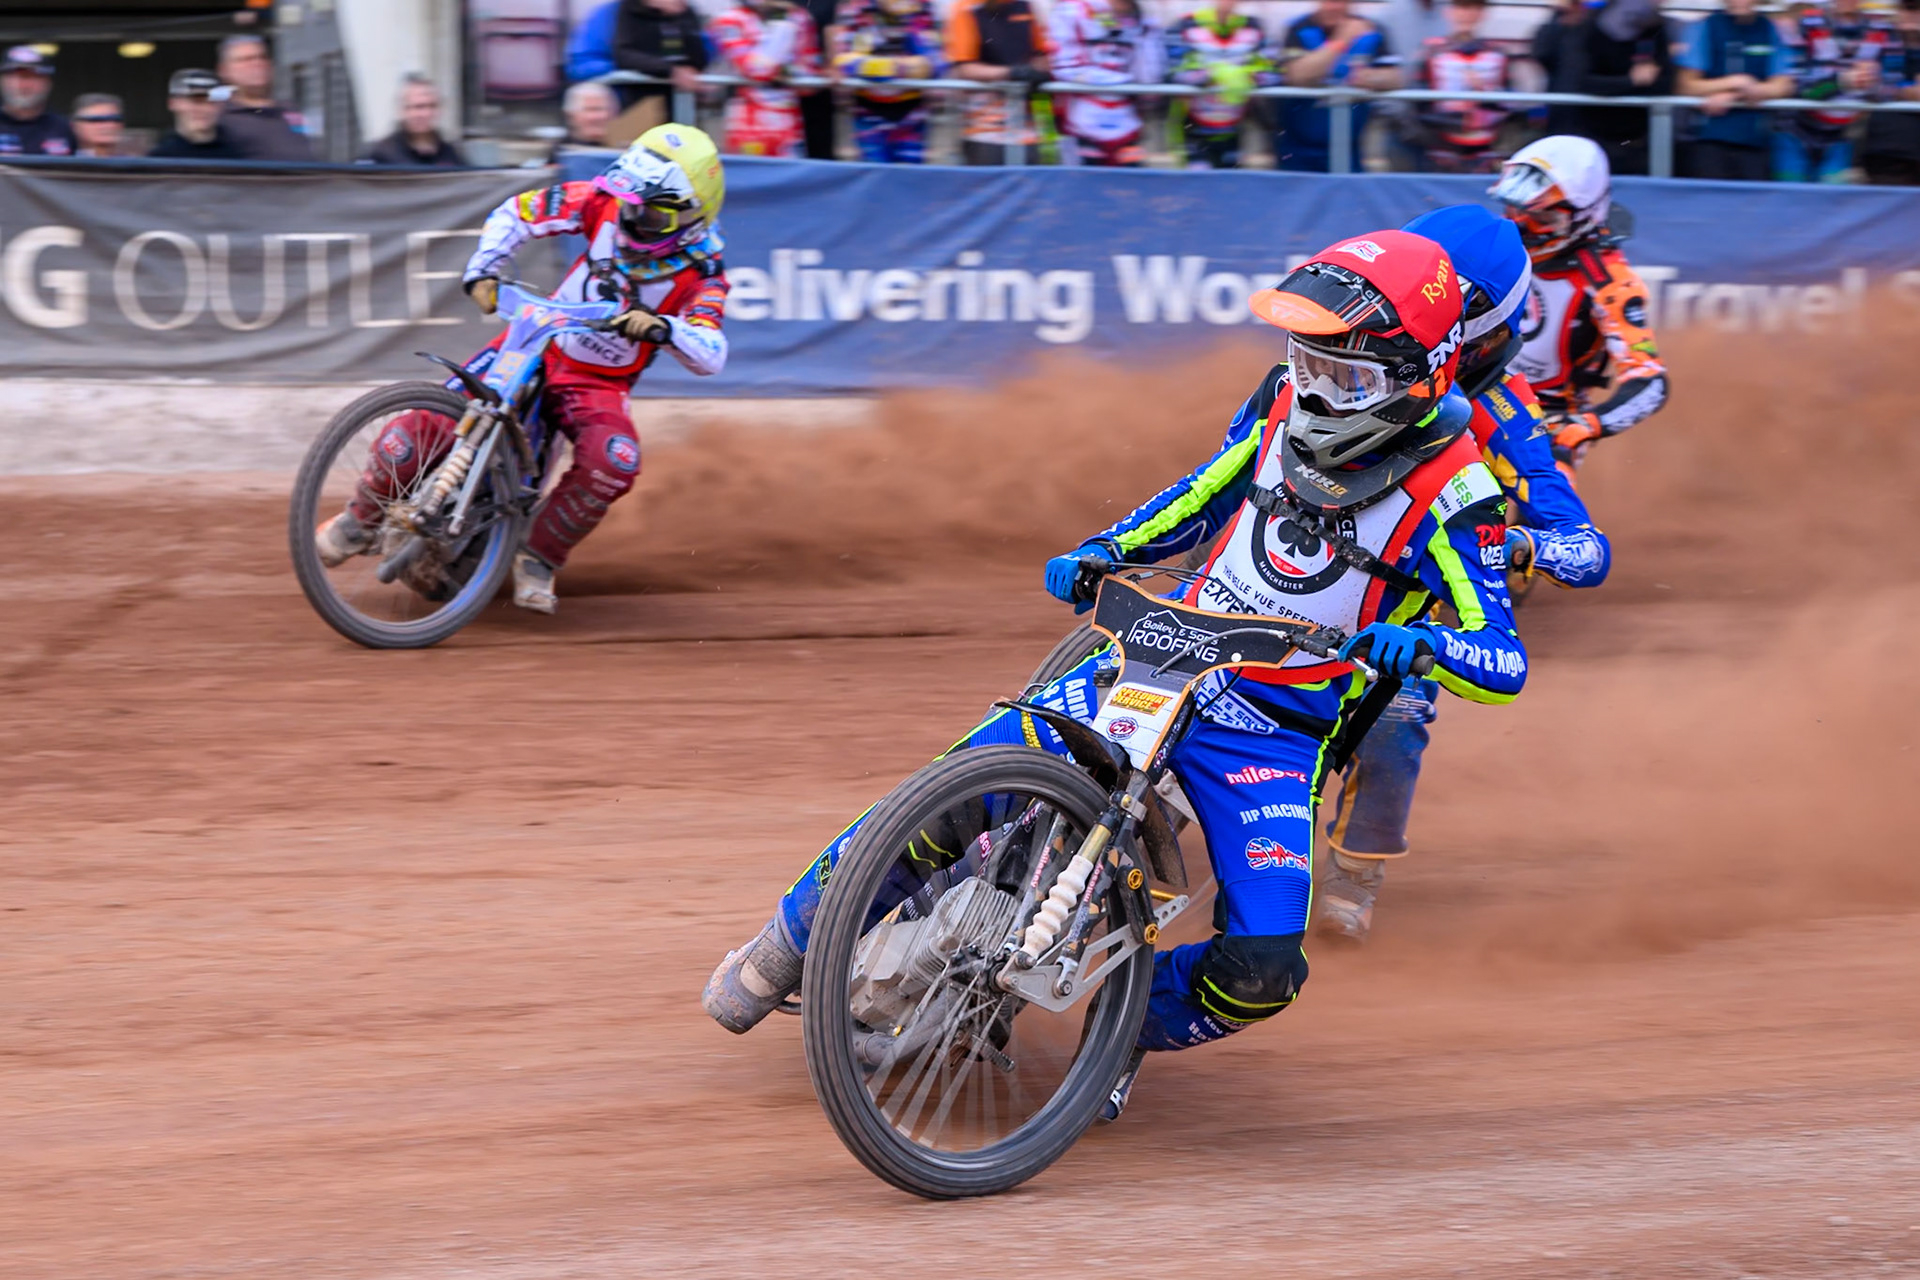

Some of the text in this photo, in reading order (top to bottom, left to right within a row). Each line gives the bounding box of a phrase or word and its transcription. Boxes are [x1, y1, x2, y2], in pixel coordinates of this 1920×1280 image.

[113, 229, 492, 331] OUTLE
[1421, 259, 1449, 305] Ryan
[727, 248, 1094, 344] elivering
[1259, 560, 1304, 590] MANCHESTER
[1254, 590, 1276, 610] VUE
[1142, 619, 1177, 637] Bailey
[1482, 649, 1494, 672] &
[1240, 803, 1311, 825] JIP RACING
